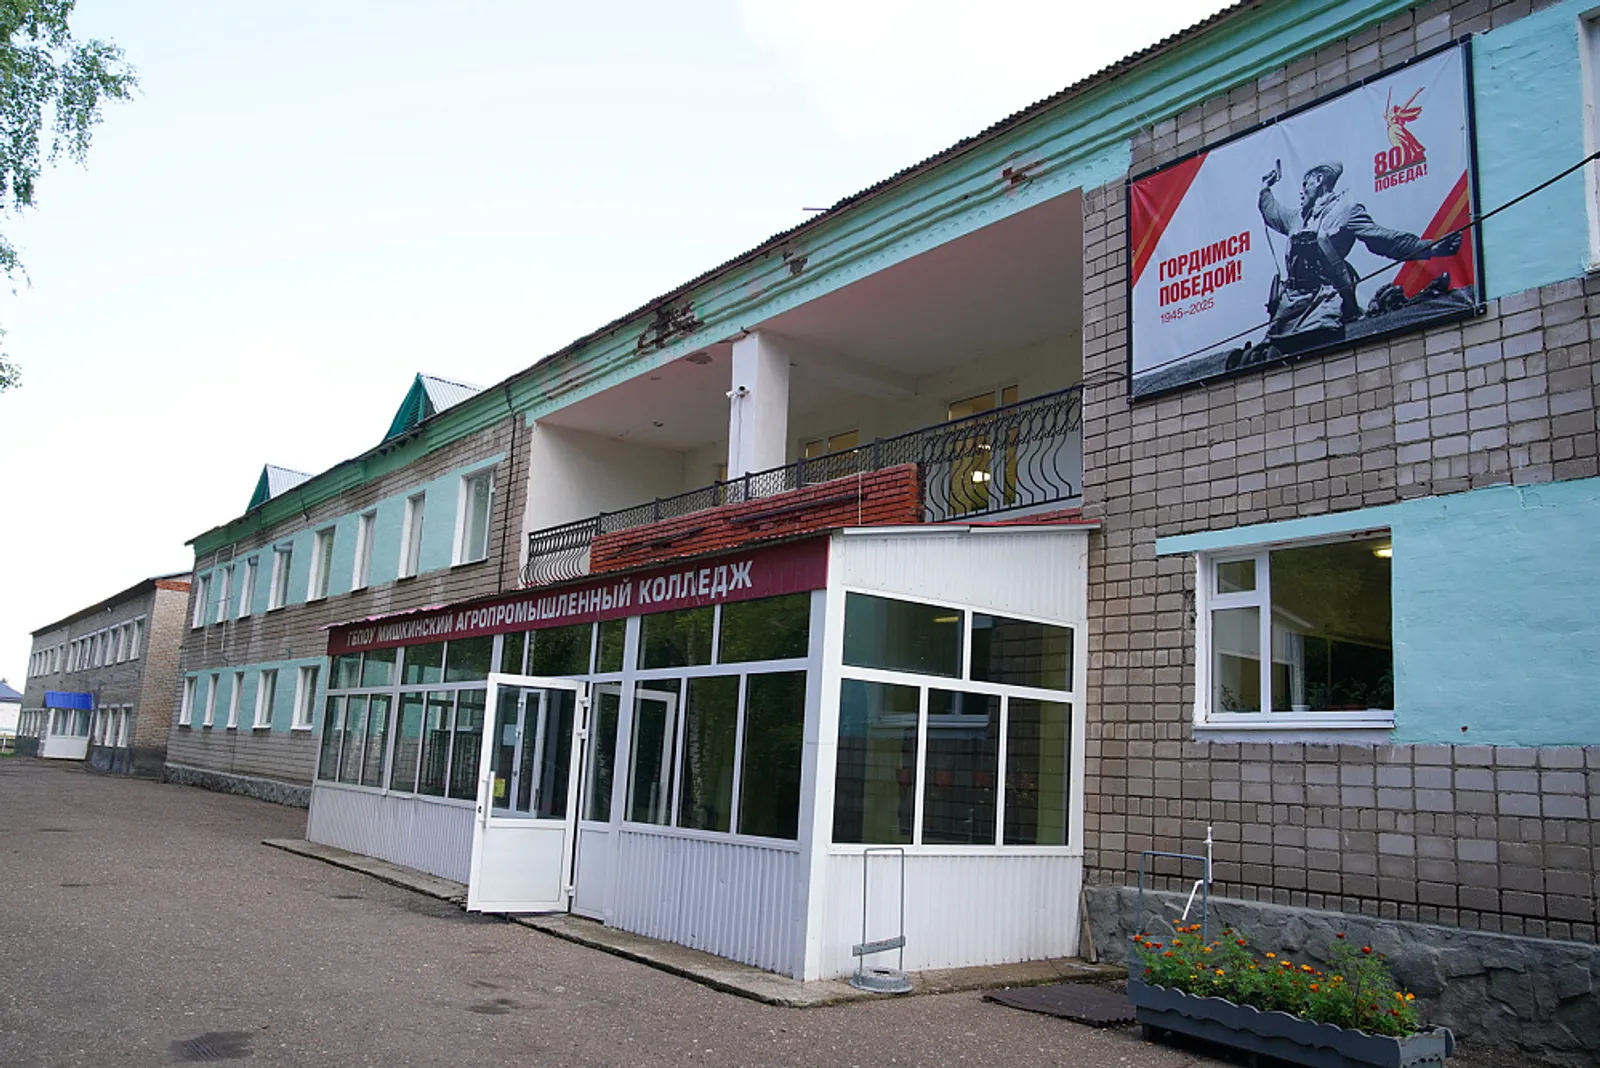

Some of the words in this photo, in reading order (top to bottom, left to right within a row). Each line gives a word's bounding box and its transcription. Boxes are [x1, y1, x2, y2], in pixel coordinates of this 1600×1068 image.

[1374, 145, 1403, 176] 80
[1374, 163, 1428, 193] ПОБЕДА!
[1159, 230, 1250, 282] ГОРДИМСЯ
[1159, 260, 1242, 307] ПОБЕДОЙ!
[376, 610, 453, 643] МИШКИНСКИЙ
[455, 577, 632, 631] АГРОПРОМЫШЛЕННЫЙ
[639, 560, 752, 604] КОЛЛЕДЖ
